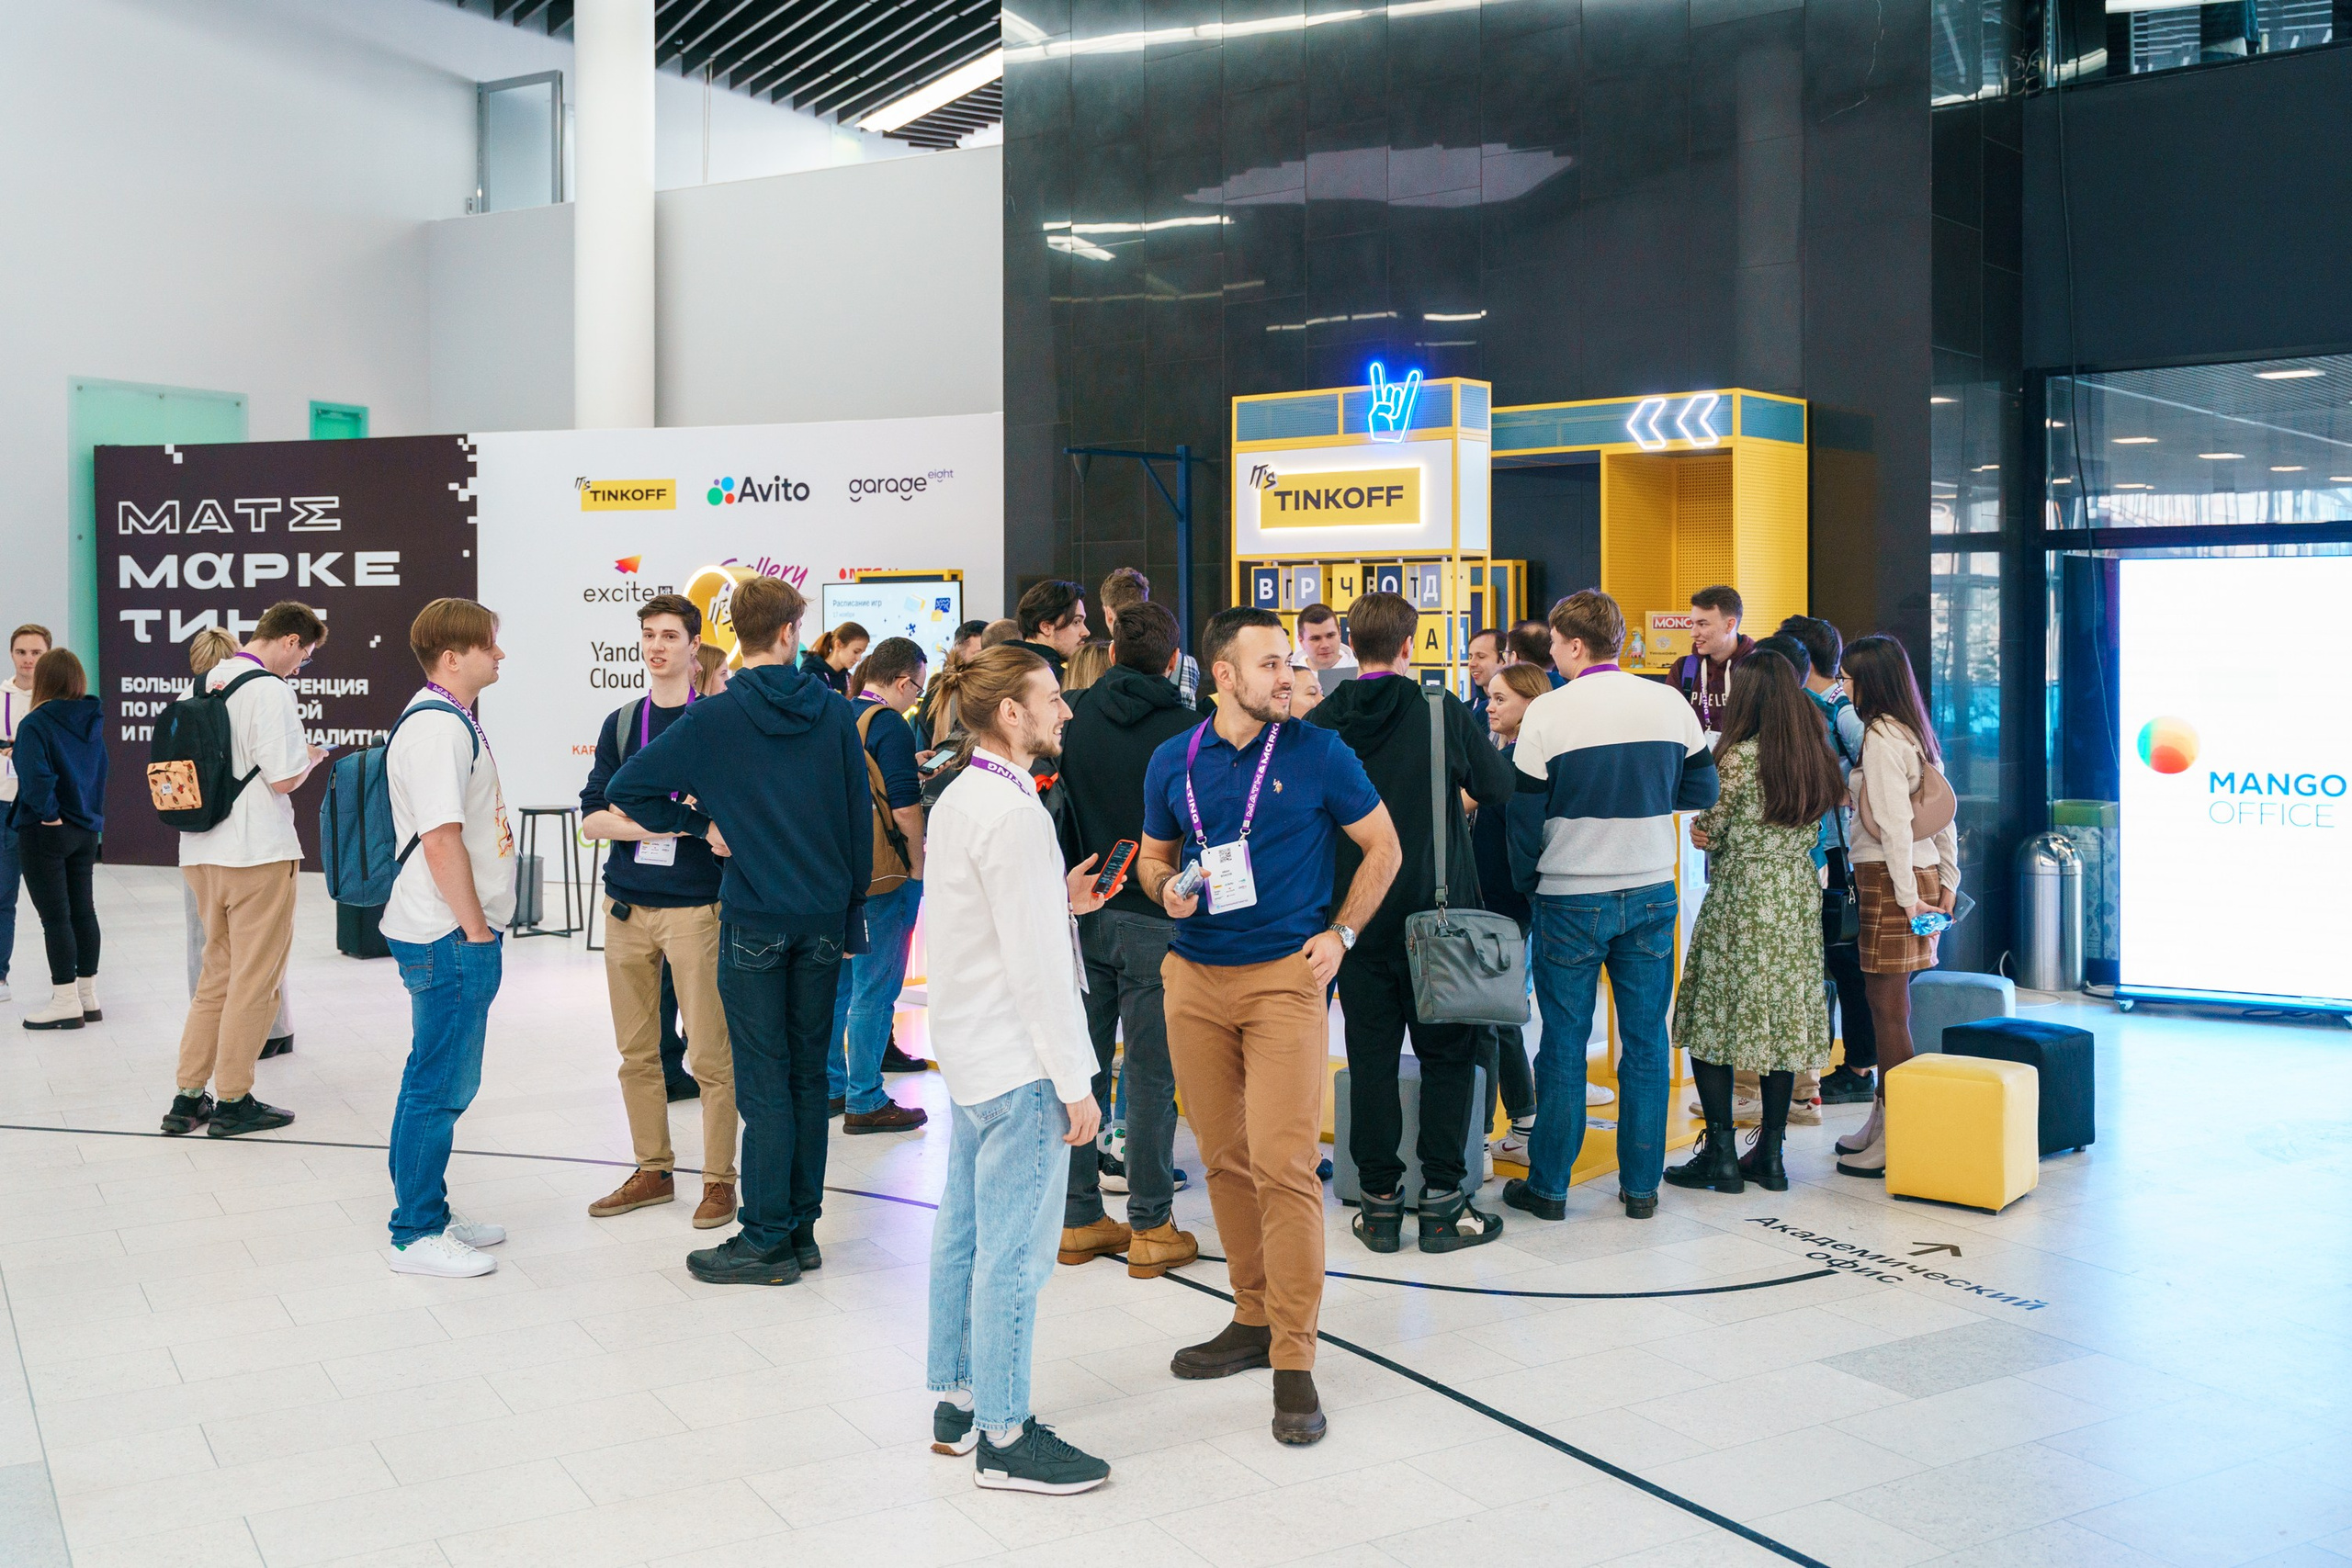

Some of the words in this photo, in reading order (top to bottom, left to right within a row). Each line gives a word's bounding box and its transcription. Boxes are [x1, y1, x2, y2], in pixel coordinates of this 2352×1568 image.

[590, 489, 667, 502] TINKOFF
[738, 475, 809, 502] Avito
[849, 477, 927, 502] garage
[927, 468, 954, 482] eight
[1274, 485, 1404, 511] TINKOFF
[583, 581, 654, 602] excite
[1260, 578, 1273, 600] В
[1301, 577, 1315, 599] Р
[119, 609, 327, 643] ТИН
[591, 641, 643, 662] Yand
[120, 677, 195, 694] БОЛЬШ
[288, 678, 369, 698] РЕНЦИЯ
[590, 668, 645, 689] Cloud
[121, 701, 147, 717] ПО
[121, 725, 136, 741] И
[2210, 772, 2346, 797] MANGO
[2210, 800, 2335, 828] OFFICE
[1745, 1217, 2050, 1312] Академический
[1805, 1251, 1904, 1284] офис
